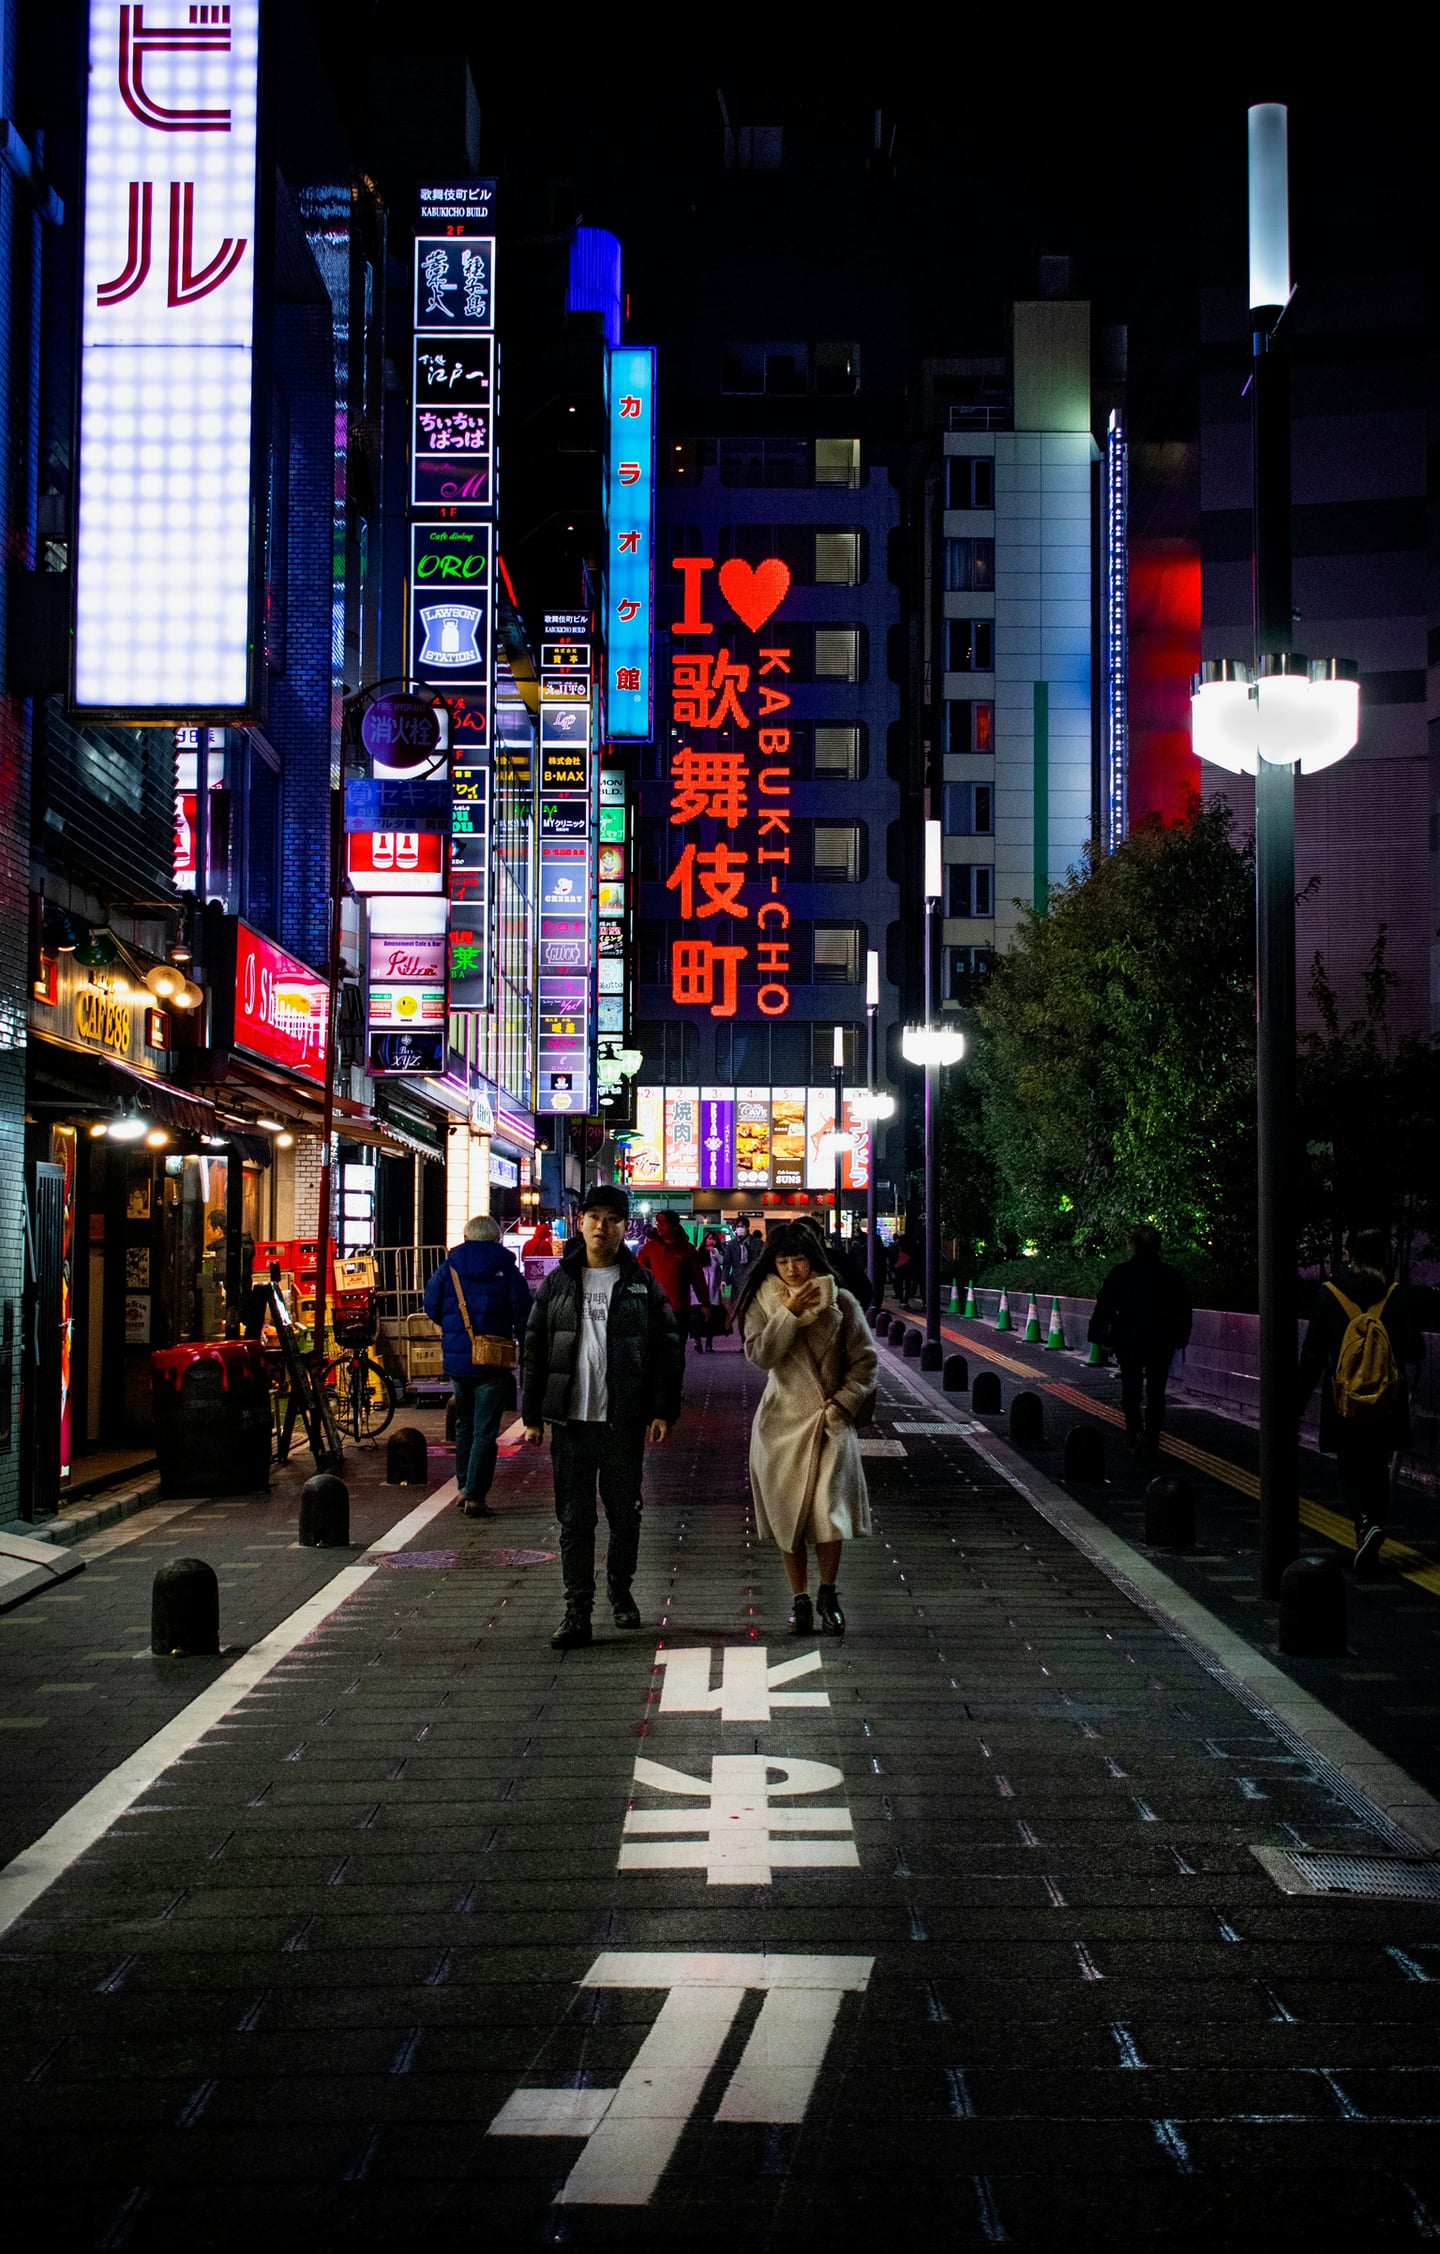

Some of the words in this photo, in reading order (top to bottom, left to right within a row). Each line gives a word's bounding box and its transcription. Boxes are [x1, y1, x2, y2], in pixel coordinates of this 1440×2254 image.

[97, 4, 248, 308] ビル
[420, 188, 492, 201] 歌舞伎町ビル
[421, 207, 465, 217] KABUKICHO
[466, 207, 488, 217] BUILD
[440, 473, 487, 499] M
[429, 531, 448, 541] Cafe
[449, 531, 474, 542] dining
[616, 395, 642, 691] カラオケ館
[417, 554, 486, 579] ORO
[671, 557, 715, 635] I
[426, 608, 477, 621] LAWSON
[425, 650, 476, 663] STATION
[376, 702, 393, 712] FIRE
[394, 703, 426, 713] HYDRANT
[369, 715, 433, 745] 消火栓
[666, 647, 750, 1017] 歌舞伎町
[757, 648, 791, 1016] KABUKI-CHO
[544, 895, 583, 903] CHERRY
[76, 990, 130, 1052] CAFE88
[391, 1055, 422, 1070] XYZ
[673, 1100, 693, 1143] 焼肉
[776, 1176, 802, 1185] SUNS
